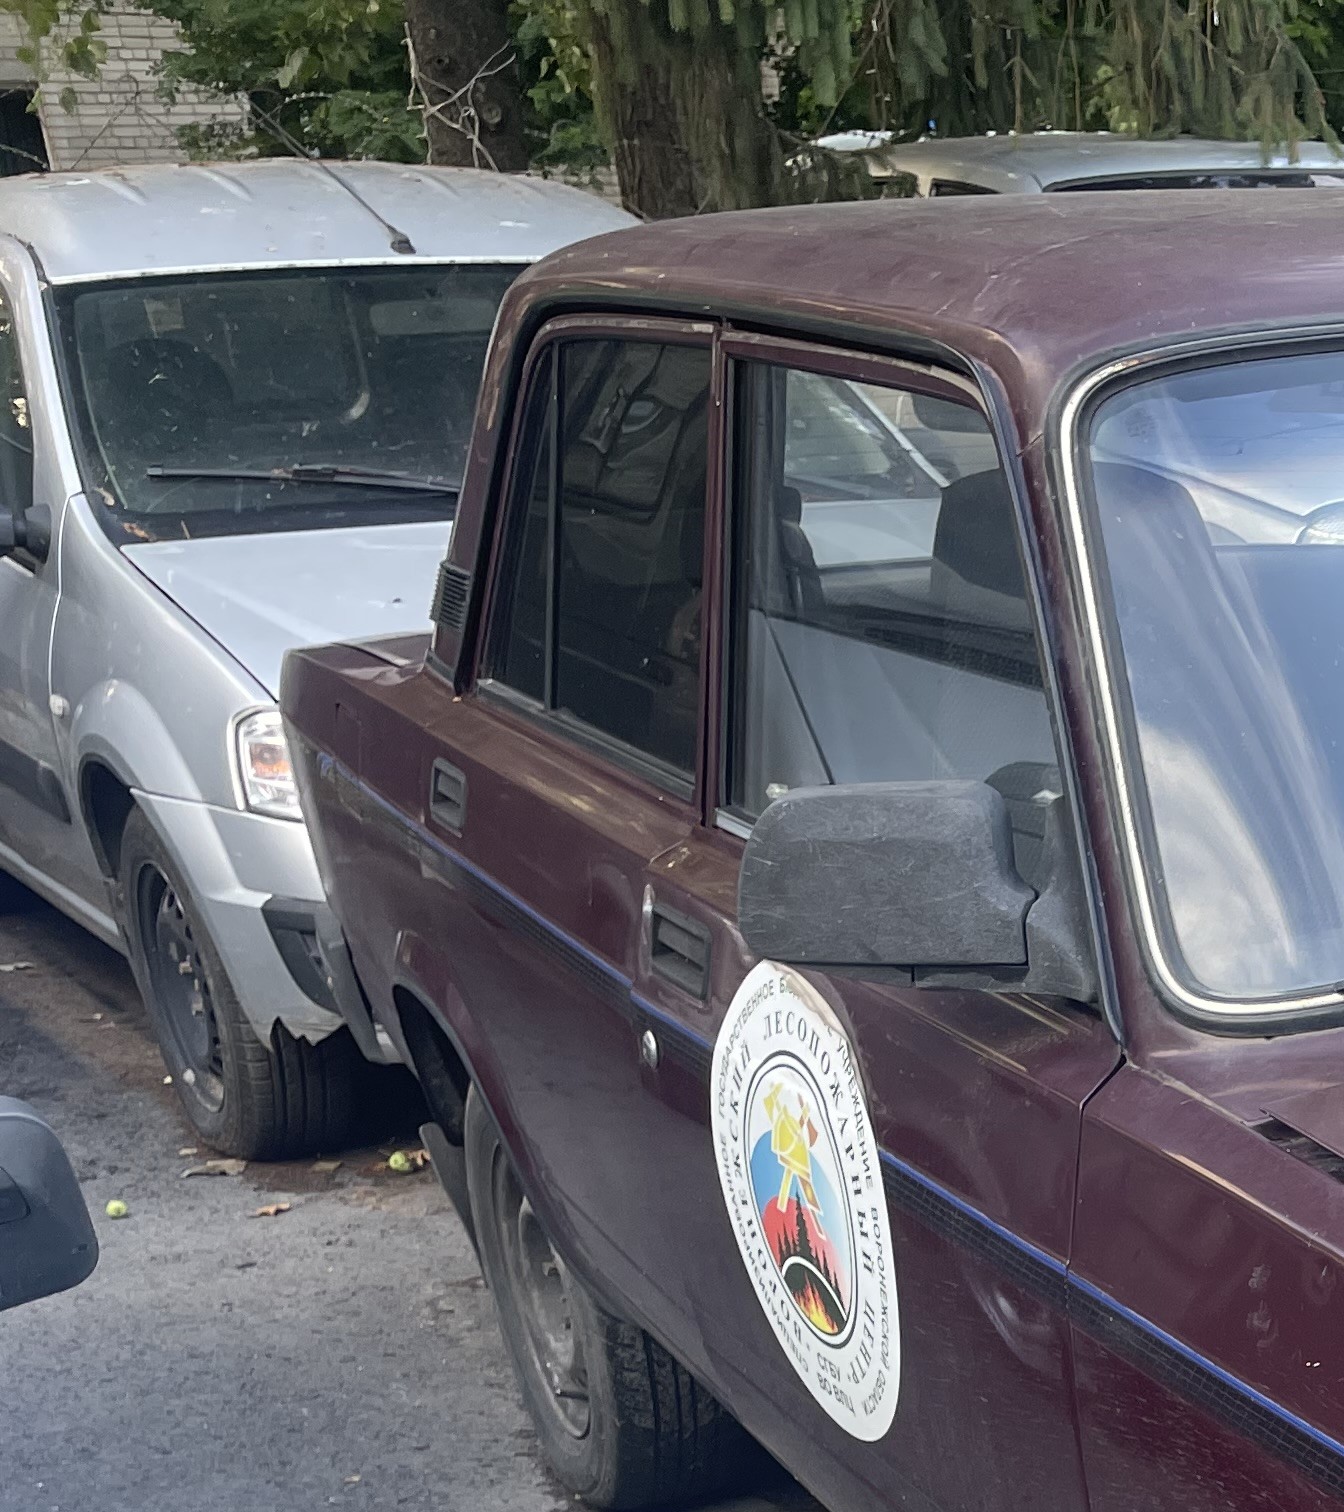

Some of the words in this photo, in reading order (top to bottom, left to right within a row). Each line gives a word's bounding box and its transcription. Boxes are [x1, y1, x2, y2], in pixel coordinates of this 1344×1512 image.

[718, 979, 774, 1120] ГОСУДАРСТВЕННОЕ
[763, 1010, 874, 1274] ЛЕСОПОЖАРНЫЙ
[850, 1298, 875, 1384] ЦЕНТР
[837, 1037, 873, 1190] УЧРЕЖДЕНИЕ
[871, 1207, 890, 1372] ВОРОНЕЖСКОЙ
